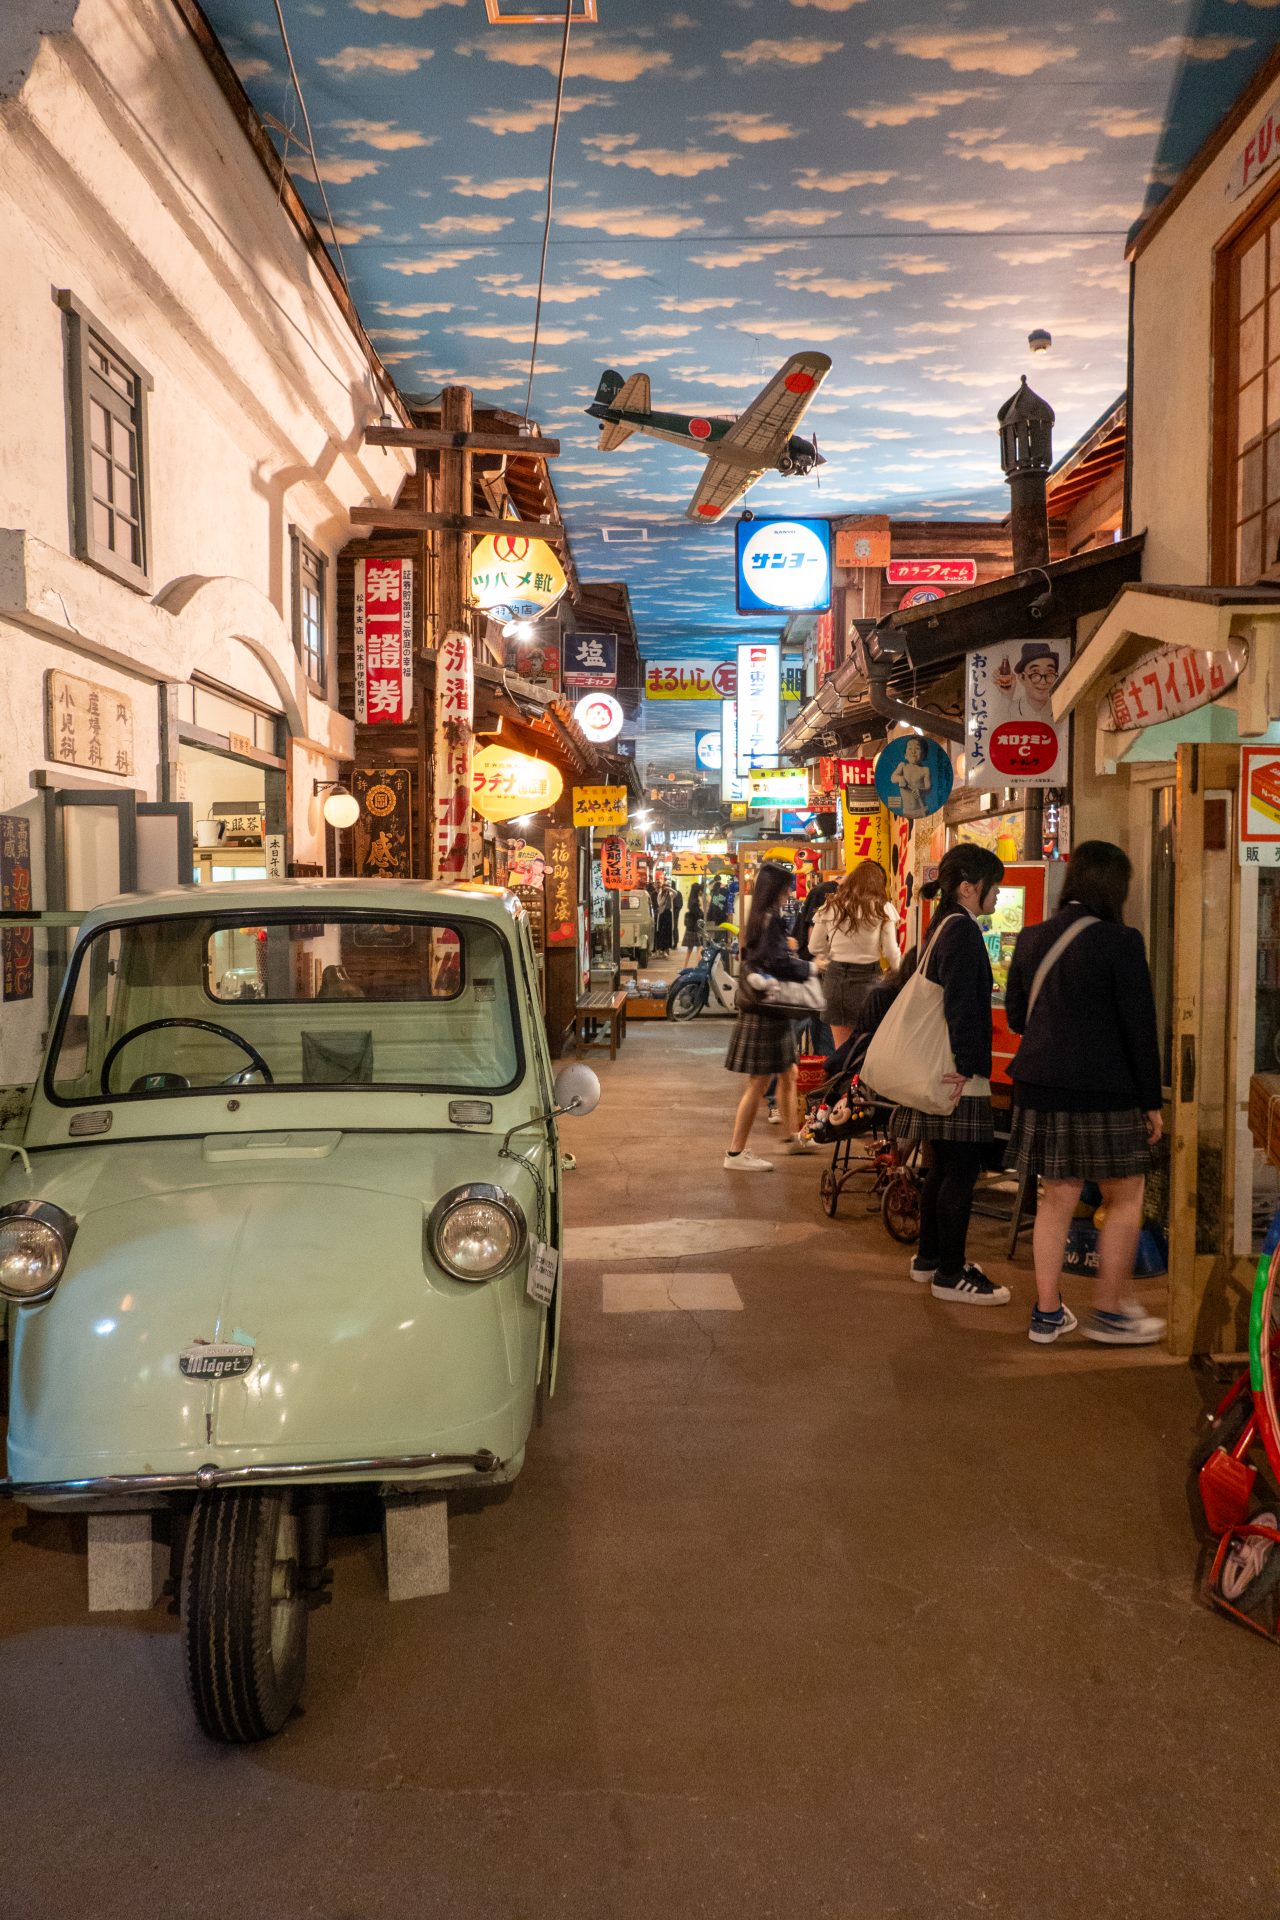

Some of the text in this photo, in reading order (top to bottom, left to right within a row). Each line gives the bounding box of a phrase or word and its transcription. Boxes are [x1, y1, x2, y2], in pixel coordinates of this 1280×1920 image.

[752, 552, 818, 569] サンヨー
[898, 564, 968, 577] カラーフォーム
[366, 568, 400, 713] 第一證券
[575, 640, 607, 667] 塩
[647, 667, 710, 692] まるいし
[997, 735, 1052, 745] オロナミン
[1018, 746, 1031, 757] C
[269, 839, 280, 878] 本日午後
[551, 842, 571, 921] 福助足袋
[186, 1355, 246, 1377] Midget
